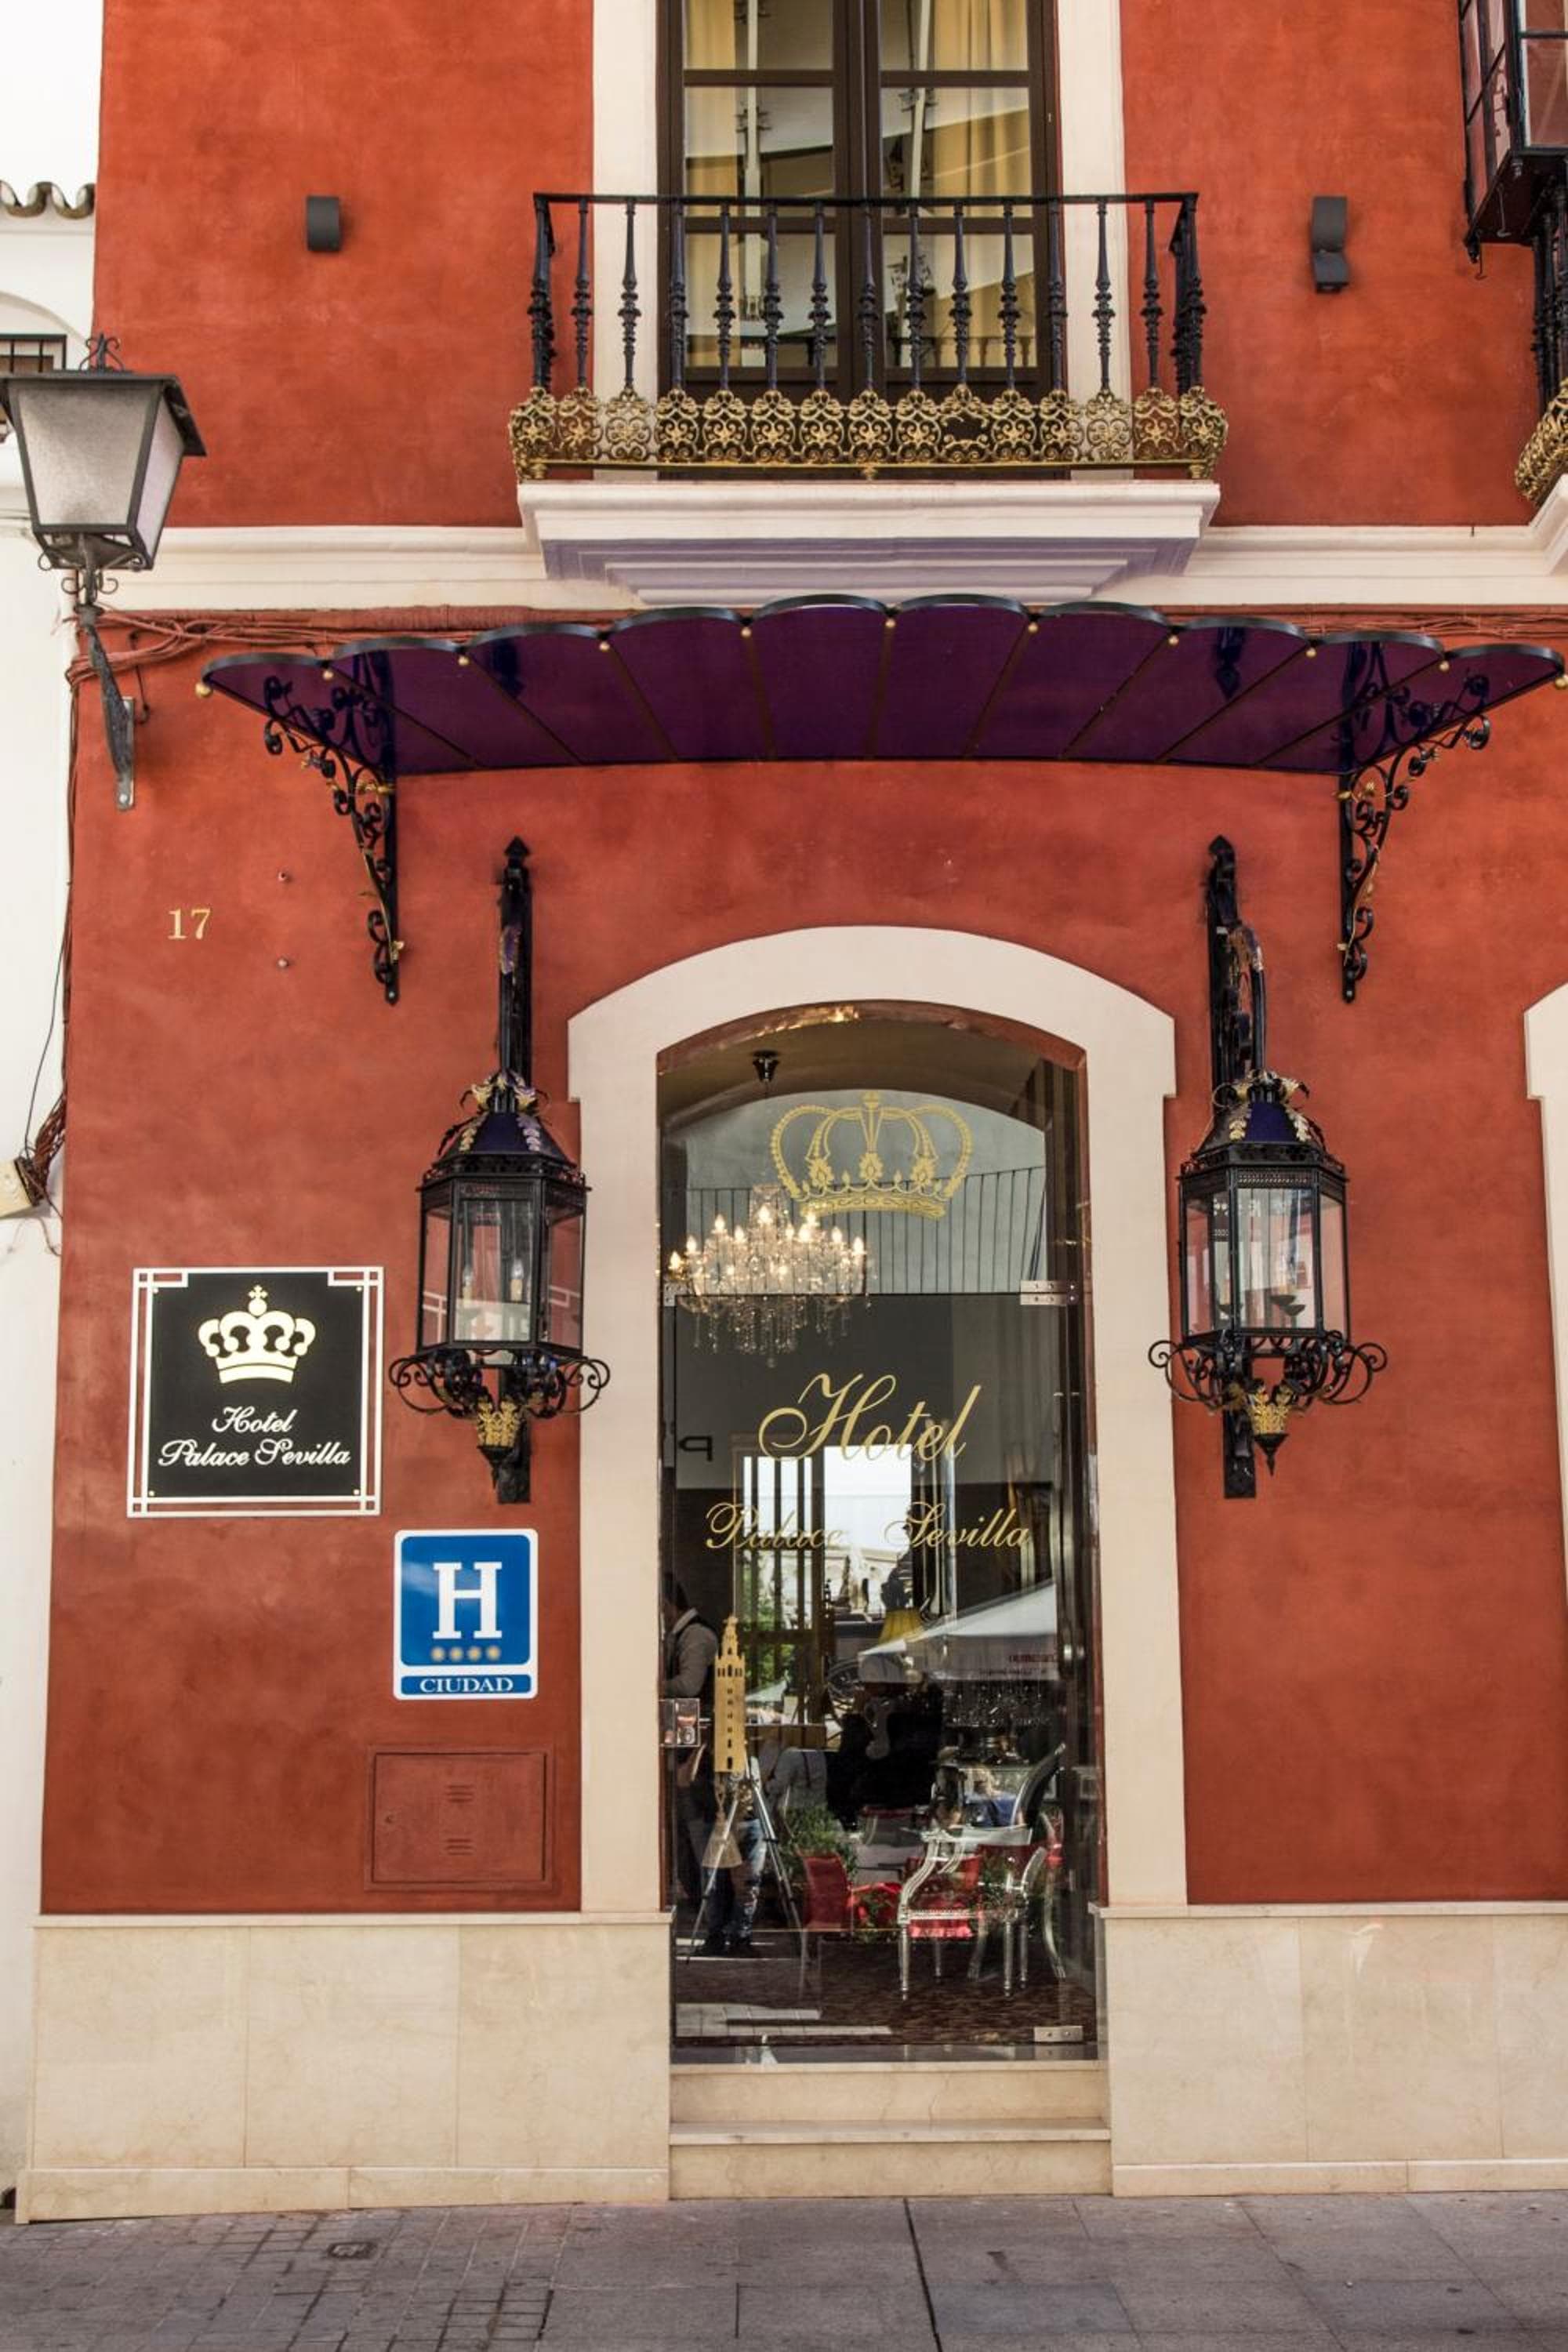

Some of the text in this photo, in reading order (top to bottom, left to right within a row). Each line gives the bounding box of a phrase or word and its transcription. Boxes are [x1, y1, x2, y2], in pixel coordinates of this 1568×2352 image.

[167, 908, 211, 940] 17
[211, 1405, 299, 1433] Hotel
[757, 1372, 982, 1462] Hotel
[158, 1438, 351, 1467] Palace Sevilla
[705, 1501, 1031, 1550] Palace Sevilla
[433, 1562, 503, 1639] H
[419, 1676, 514, 1693] CIUDAD
